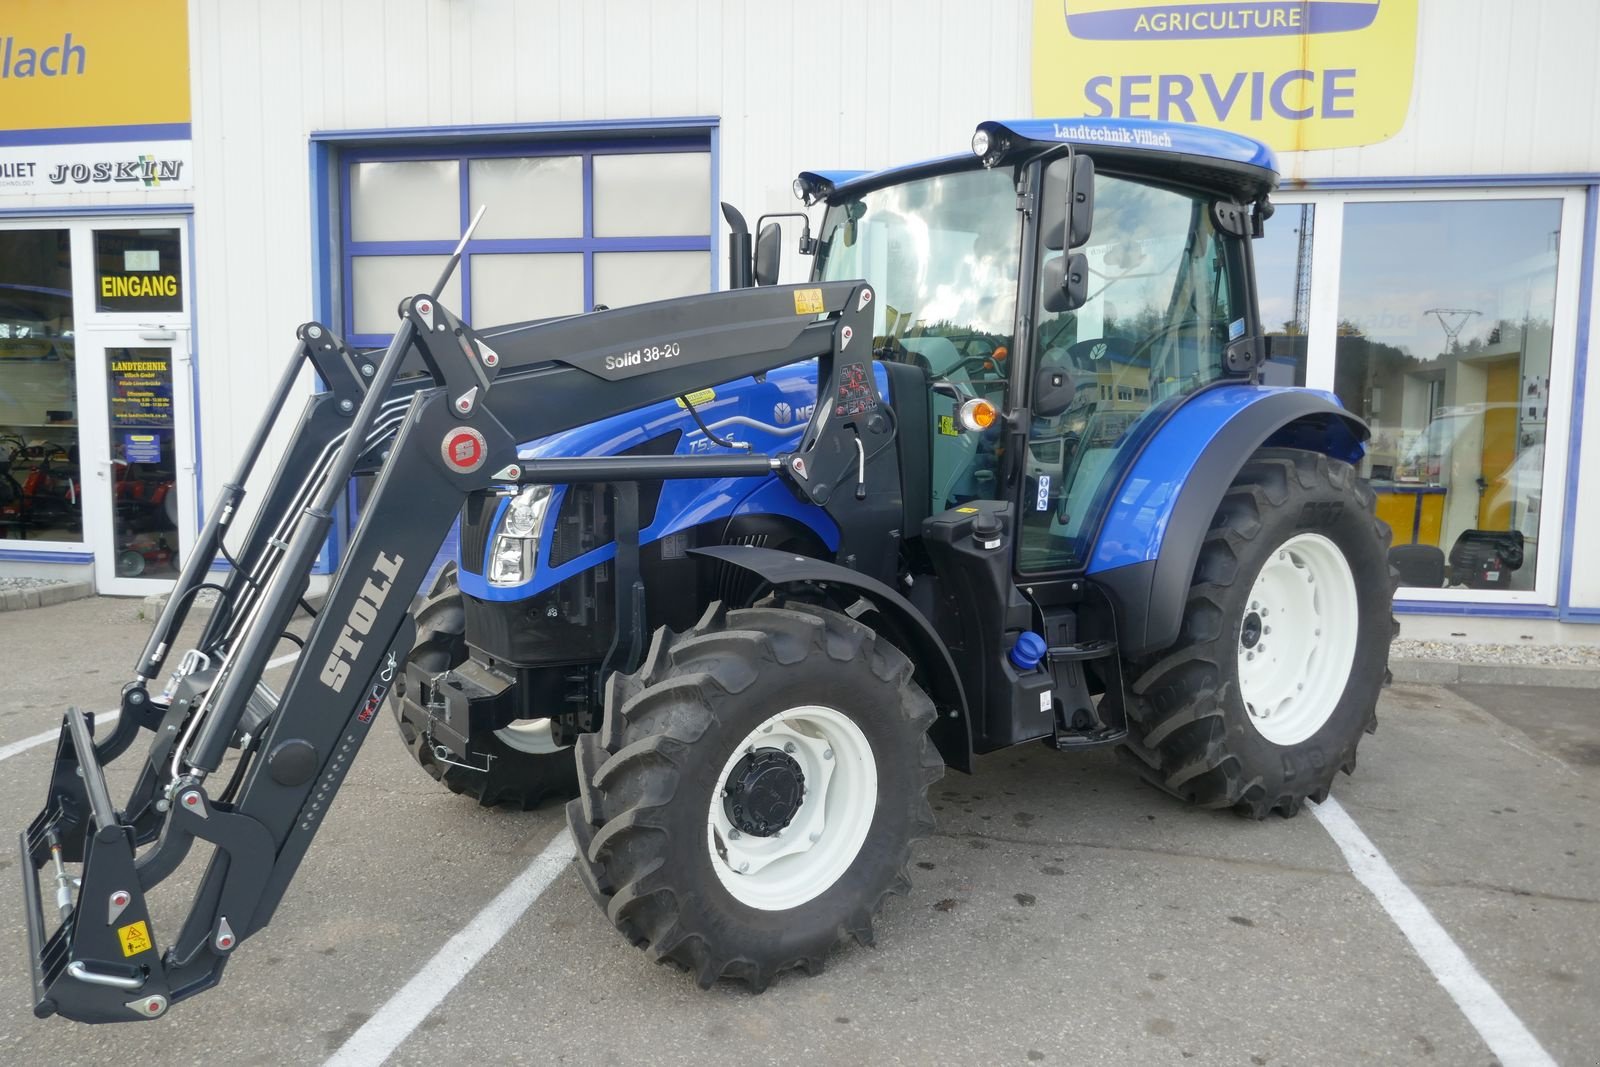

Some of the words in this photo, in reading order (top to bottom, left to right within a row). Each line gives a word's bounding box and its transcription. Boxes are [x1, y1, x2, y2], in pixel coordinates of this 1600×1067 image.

[1134, 8, 1302, 32] AGRICULTURE
[0, 32, 87, 79] lach
[1083, 69, 1357, 122] SERVICE
[1054, 123, 1172, 148] Landtechnik-Villach
[49, 160, 184, 185] JOSKIN
[102, 275, 177, 297] EINGANG
[112, 361, 167, 371] LANDTECHNIK
[605, 350, 641, 370] Solid
[643, 343, 680, 363] 38-20
[795, 403, 816, 421] NE
[320, 551, 404, 693] STOLL
